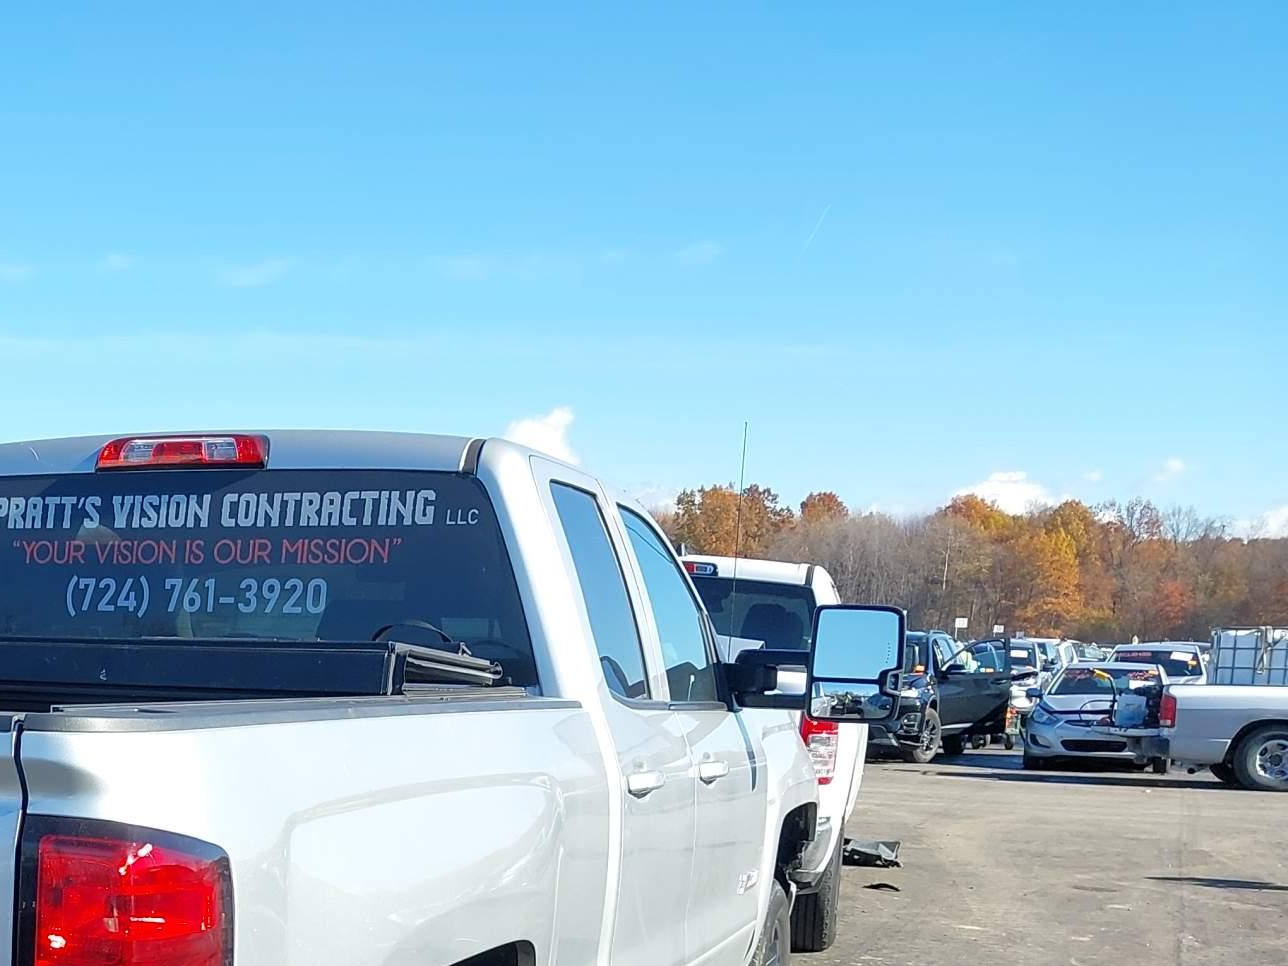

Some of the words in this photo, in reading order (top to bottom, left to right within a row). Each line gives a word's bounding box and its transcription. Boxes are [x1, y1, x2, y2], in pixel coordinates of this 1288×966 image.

[112, 494, 211, 528] VISION
[220, 489, 436, 528] CONTRACTING
[445, 508, 480, 525] LLC
[12, 539, 86, 565] "YOUR
[95, 539, 176, 565] VISION
[184, 539, 205, 565] IS
[213, 538, 272, 565] OUR
[280, 538, 402, 565] MISSION"
[66, 575, 150, 618] (724)
[164, 577, 328, 615] 761-3920
